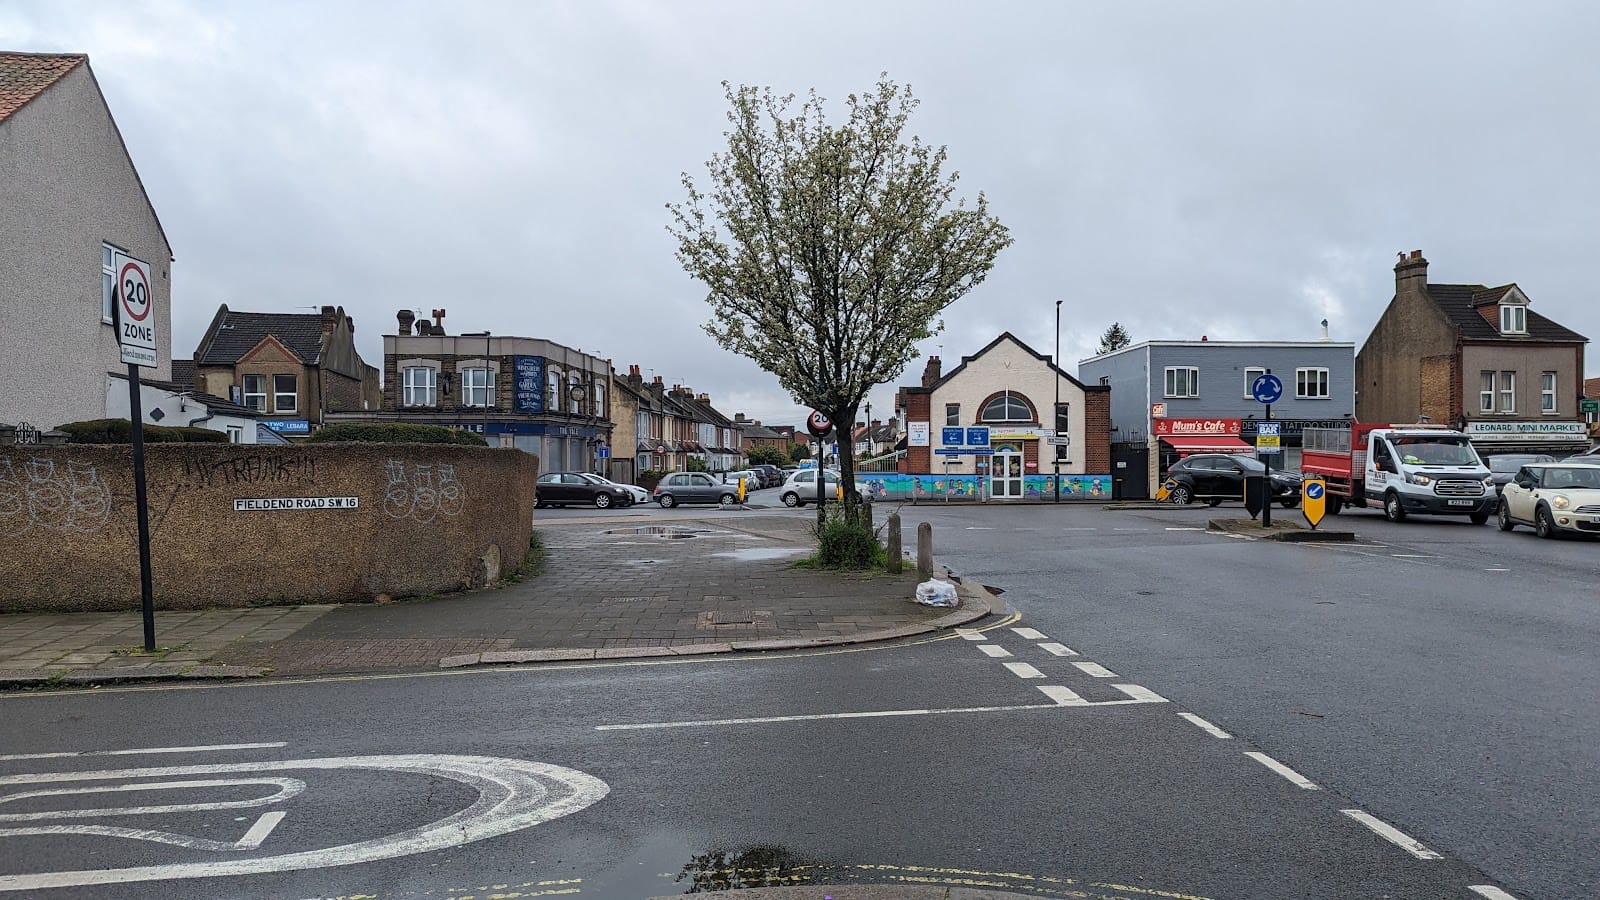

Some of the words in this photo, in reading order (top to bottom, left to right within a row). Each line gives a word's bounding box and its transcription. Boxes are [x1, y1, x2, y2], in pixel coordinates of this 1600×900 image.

[126, 279, 147, 305] 20
[124, 323, 152, 341] ZONE
[814, 414, 829, 423] 20
[1172, 421, 1202, 430] Mum's
[1203, 420, 1225, 431] Cafe
[1259, 426, 1278, 434] BAR
[1285, 422, 1319, 430] TATTOO
[1321, 422, 1352, 430] STUDIO
[236, 499, 293, 509] FIELDEND
[296, 499, 324, 508] ROAD
